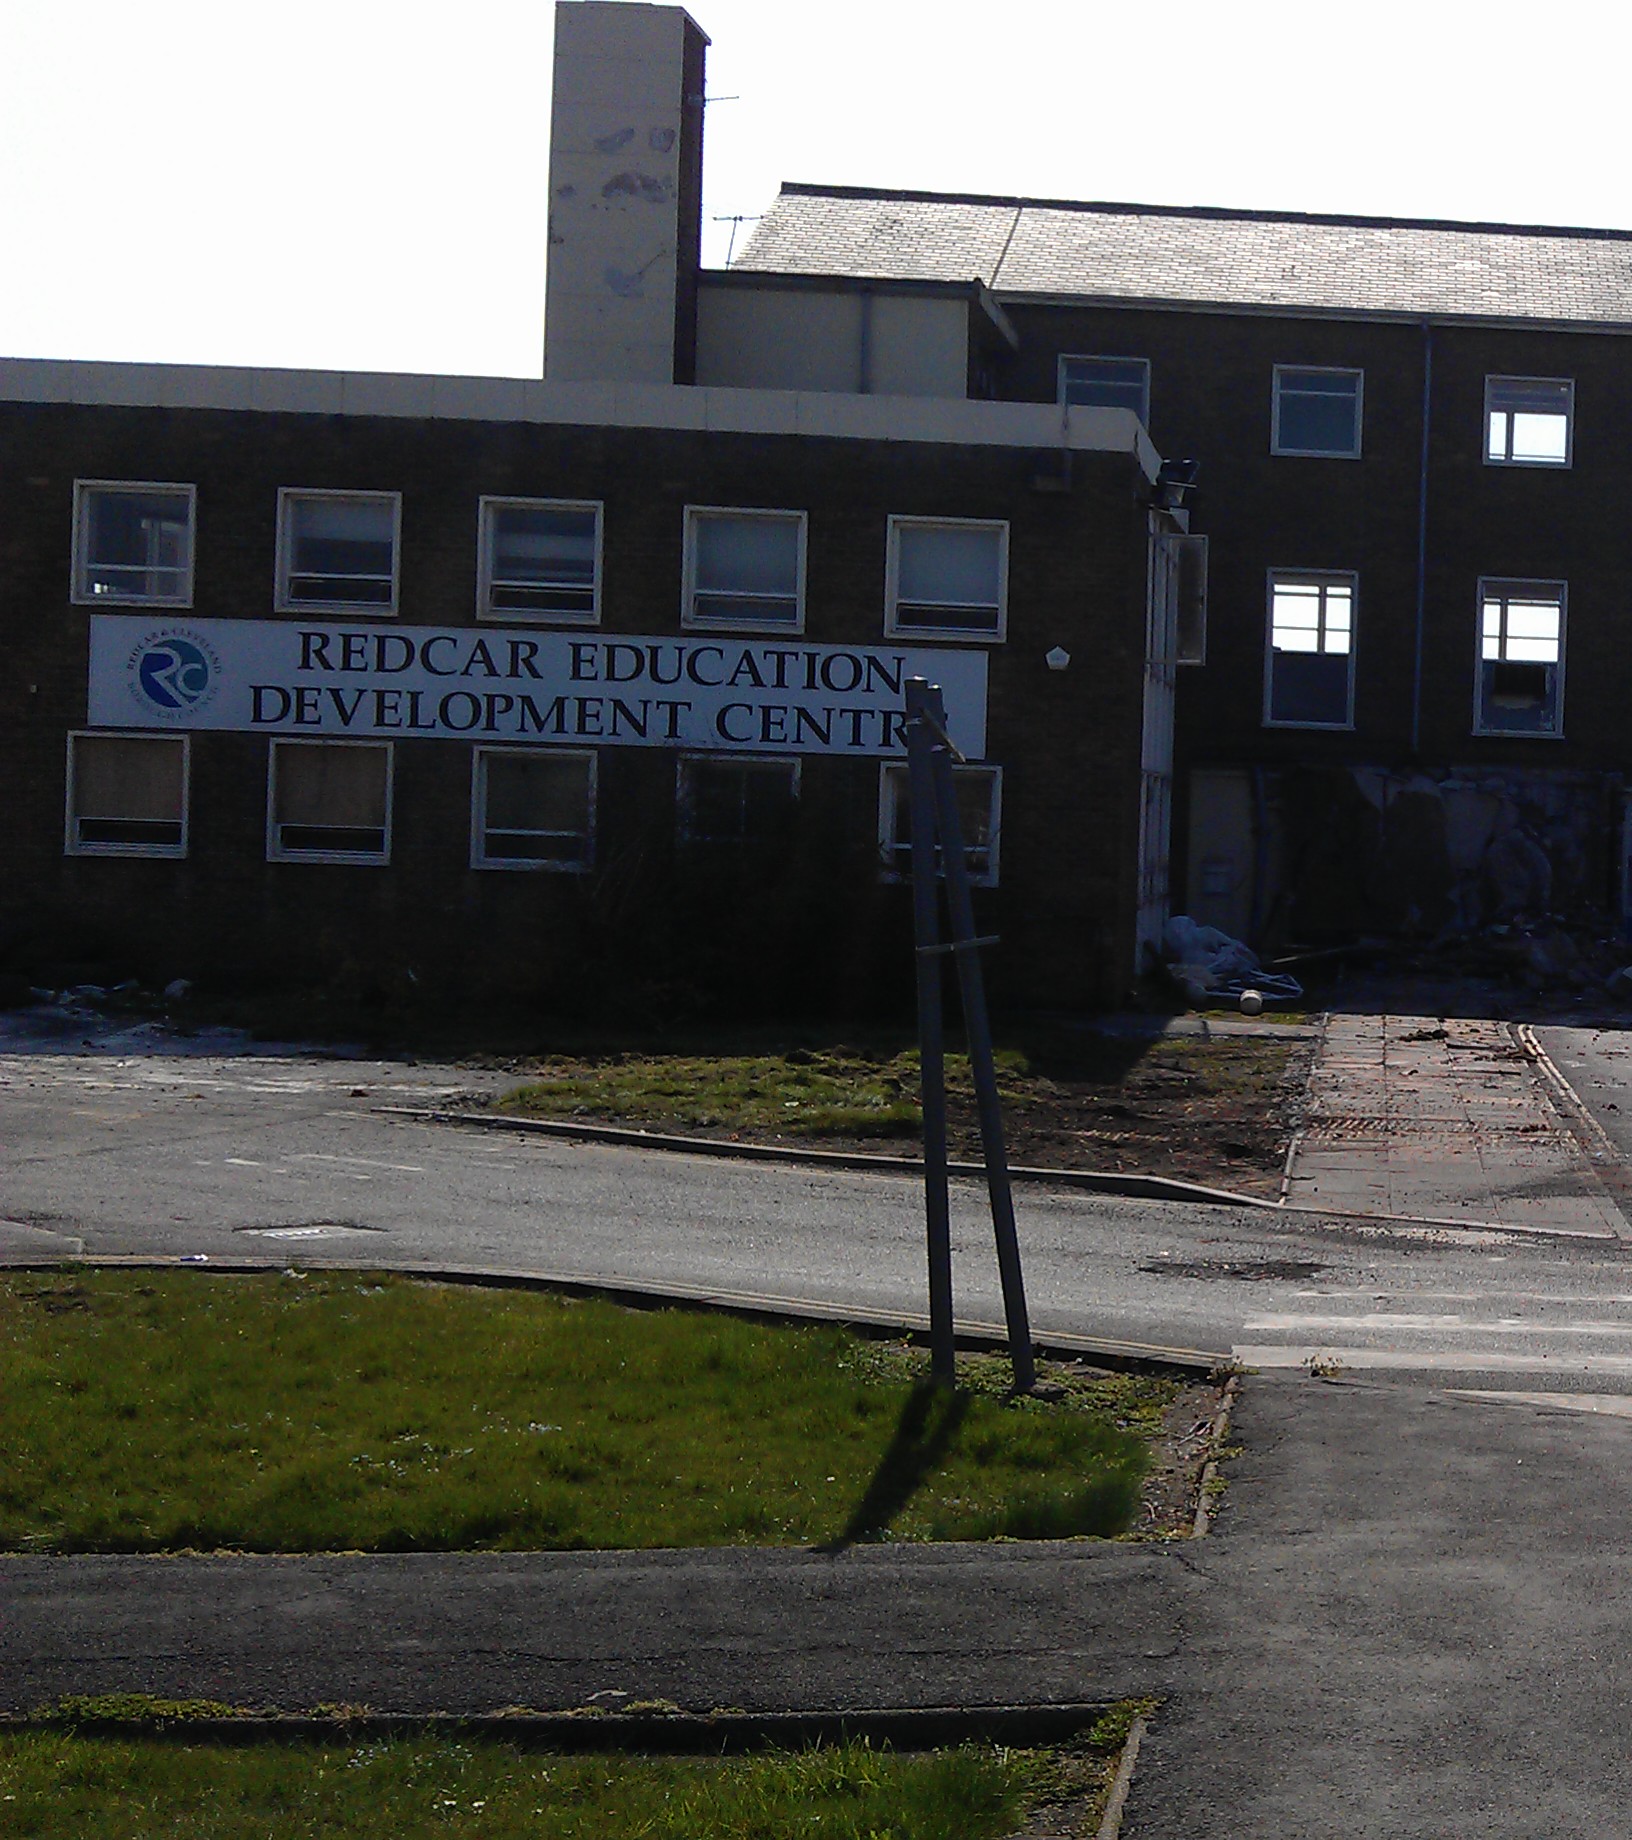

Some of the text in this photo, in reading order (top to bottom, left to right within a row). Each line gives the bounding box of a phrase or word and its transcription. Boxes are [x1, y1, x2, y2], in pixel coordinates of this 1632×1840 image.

[297, 631, 906, 695] REDCAR EDUCATION
[251, 686, 947, 750] DEVELOPMENT CENTR
